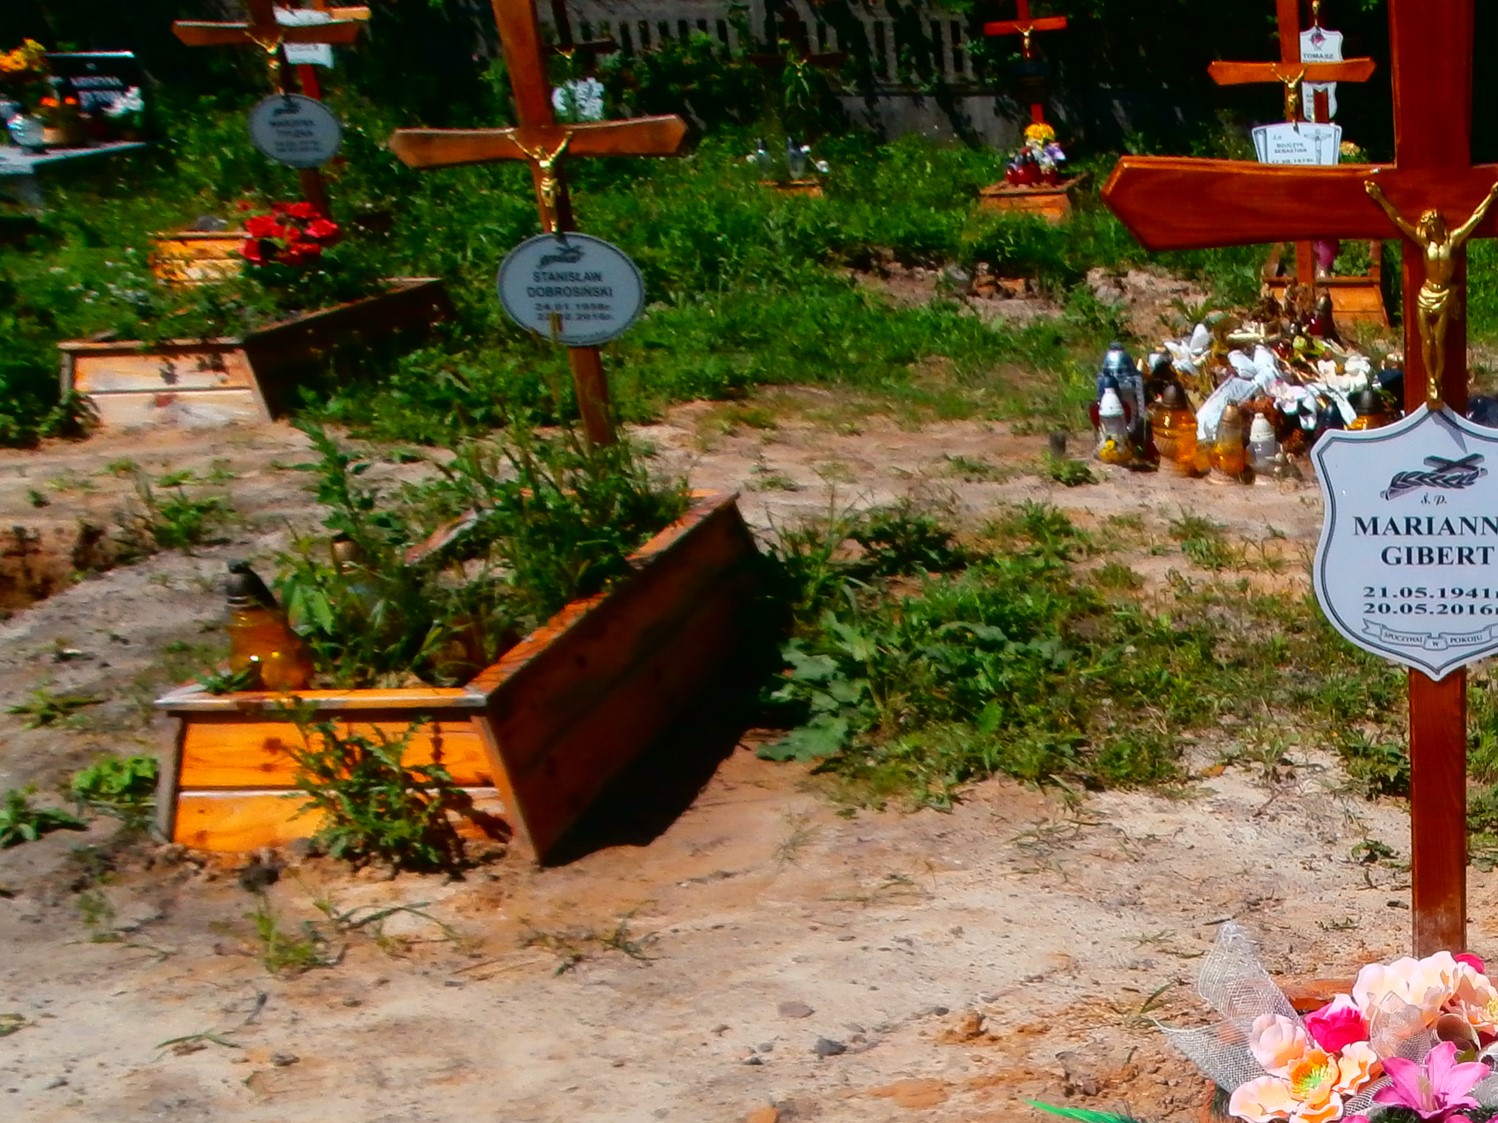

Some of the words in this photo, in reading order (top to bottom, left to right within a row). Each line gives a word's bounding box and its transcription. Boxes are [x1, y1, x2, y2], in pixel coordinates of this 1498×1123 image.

[532, 271, 603, 283] STANISŁAW
[526, 285, 614, 298] DOBROSIŃSKI
[1381, 545, 1495, 566] GIBERT
[1384, 632, 1423, 643] SPOCZYWAJ
[1449, 634, 1483, 644] POKOJU
